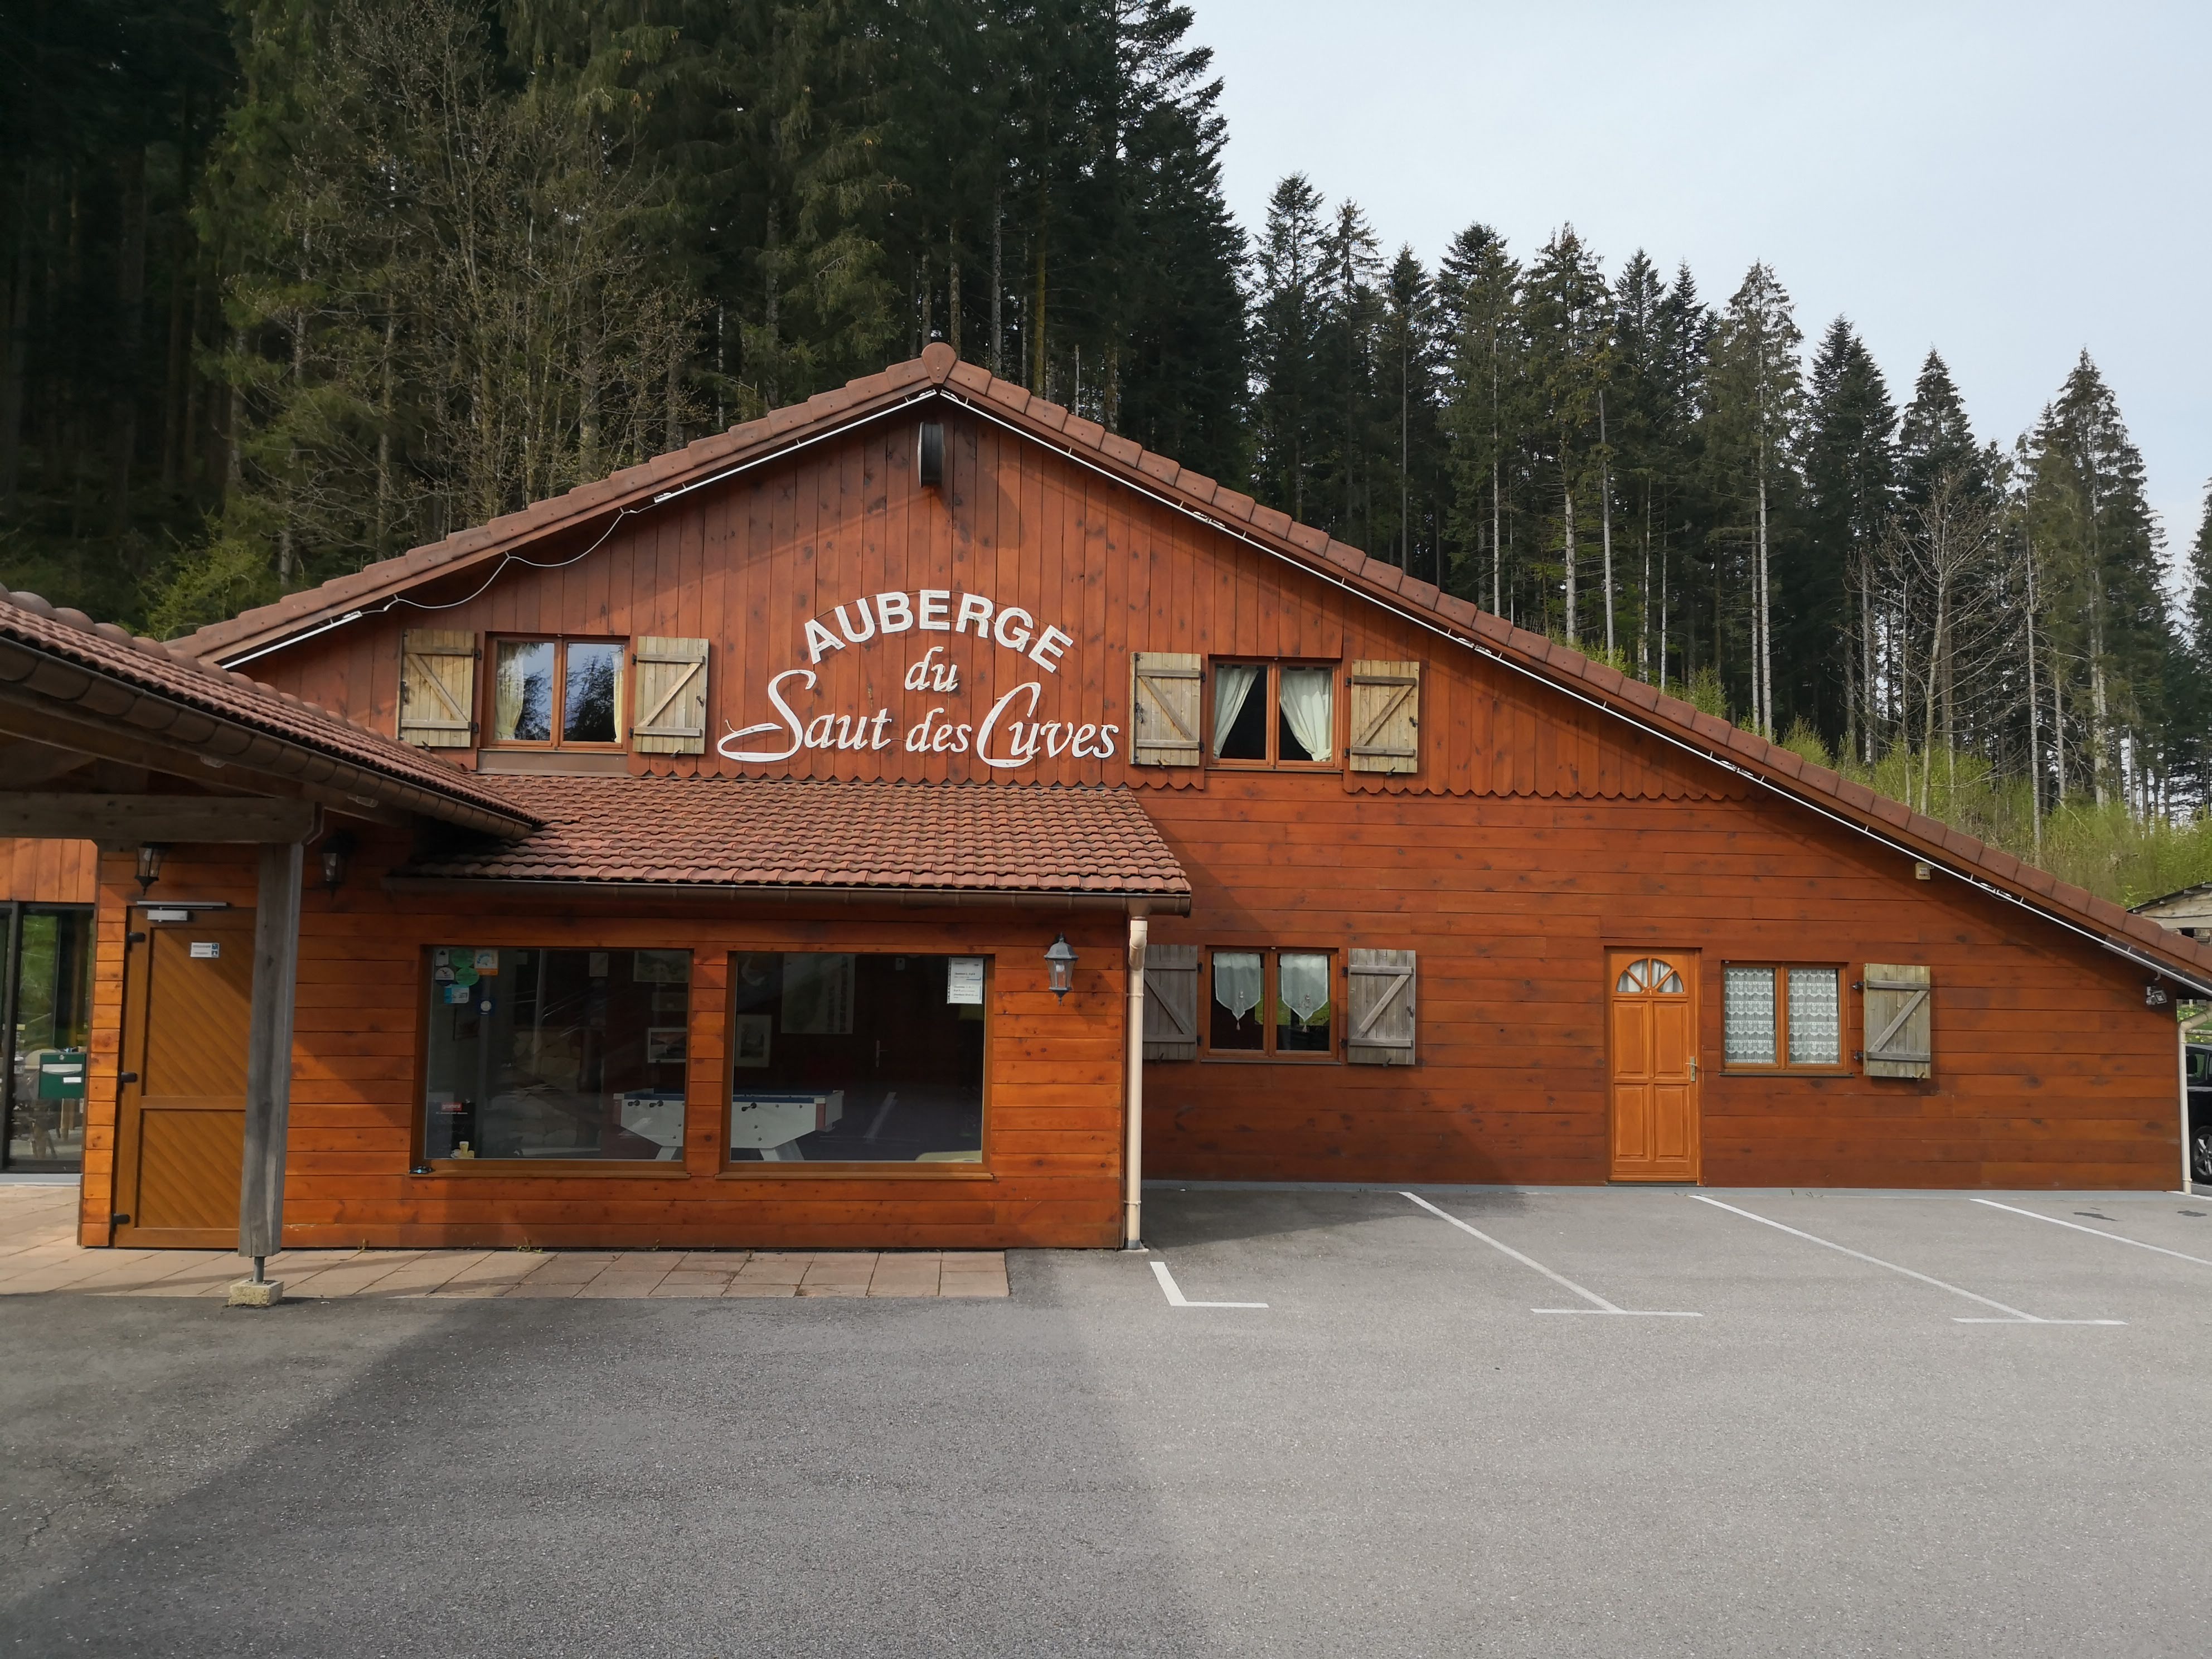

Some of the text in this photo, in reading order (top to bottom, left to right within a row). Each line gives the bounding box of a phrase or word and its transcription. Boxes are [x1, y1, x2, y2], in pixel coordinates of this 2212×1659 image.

[804, 589, 1074, 673] AUBERGE
[905, 646, 958, 692] du
[717, 669, 1119, 768] Saut des Cuves
